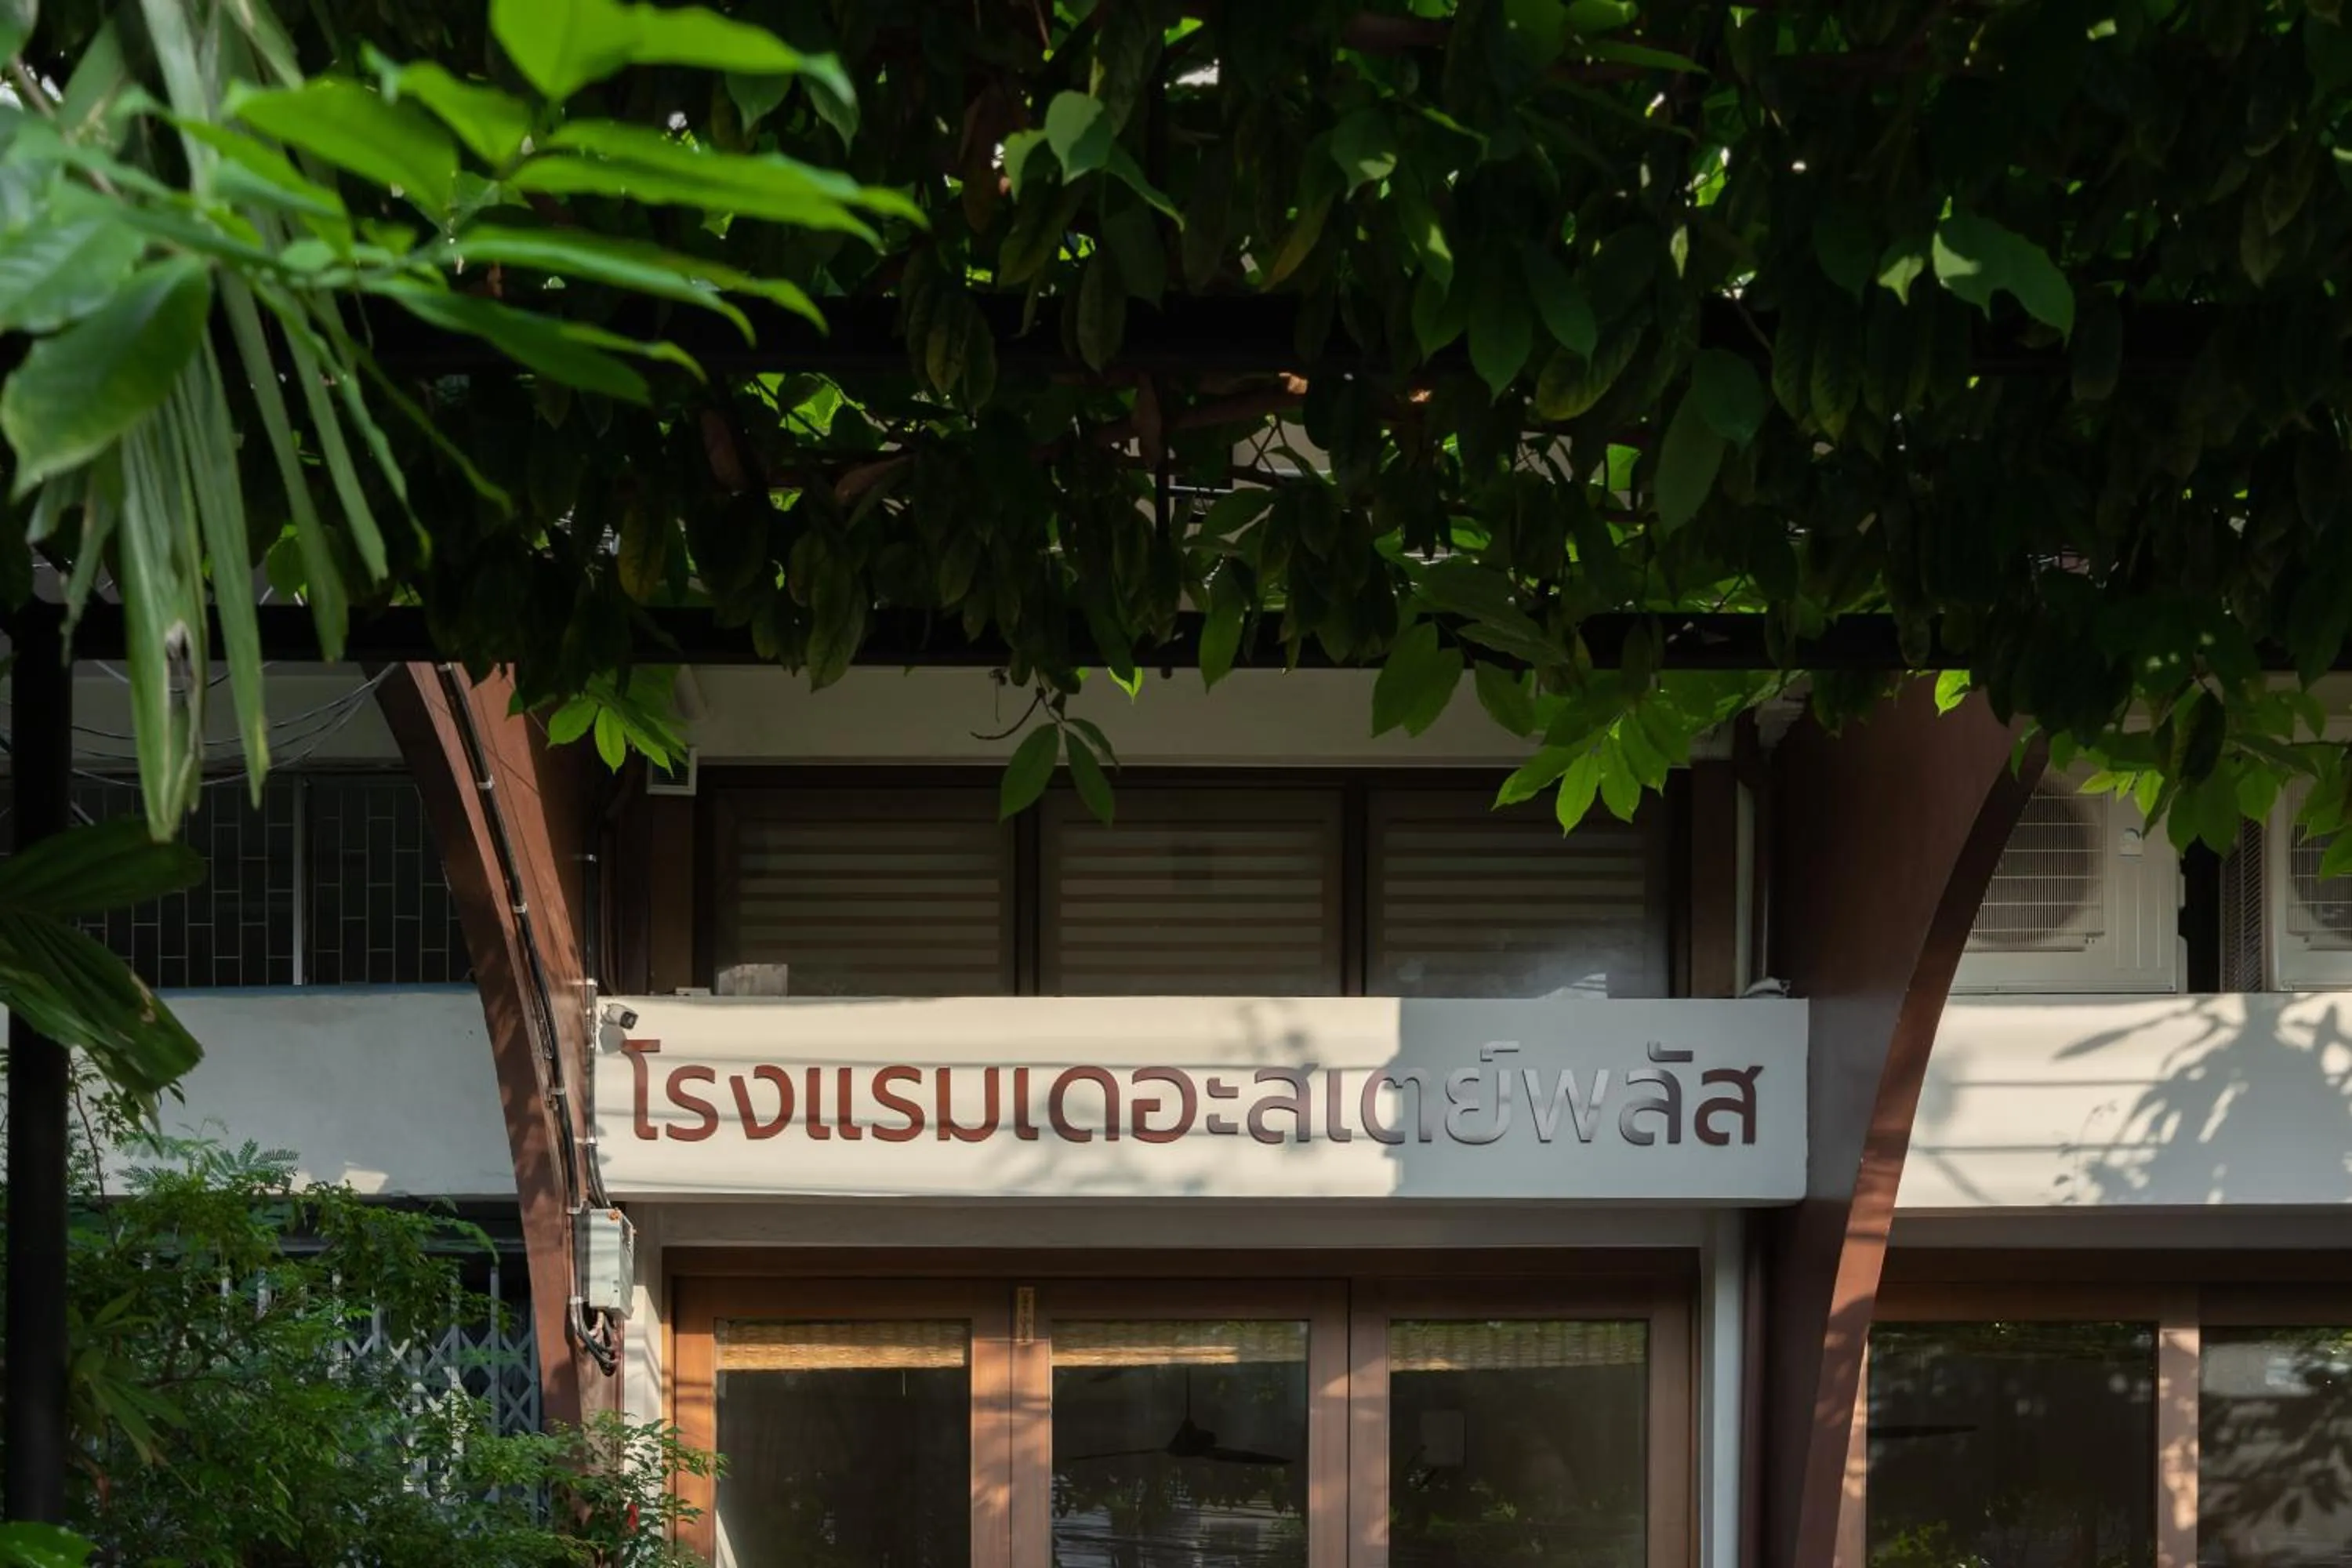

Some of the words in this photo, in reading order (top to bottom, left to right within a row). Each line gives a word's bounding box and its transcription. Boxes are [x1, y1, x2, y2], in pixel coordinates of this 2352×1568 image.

[621, 1039, 1764, 1145] โรงแรมเดอะสเตย์พลัส
